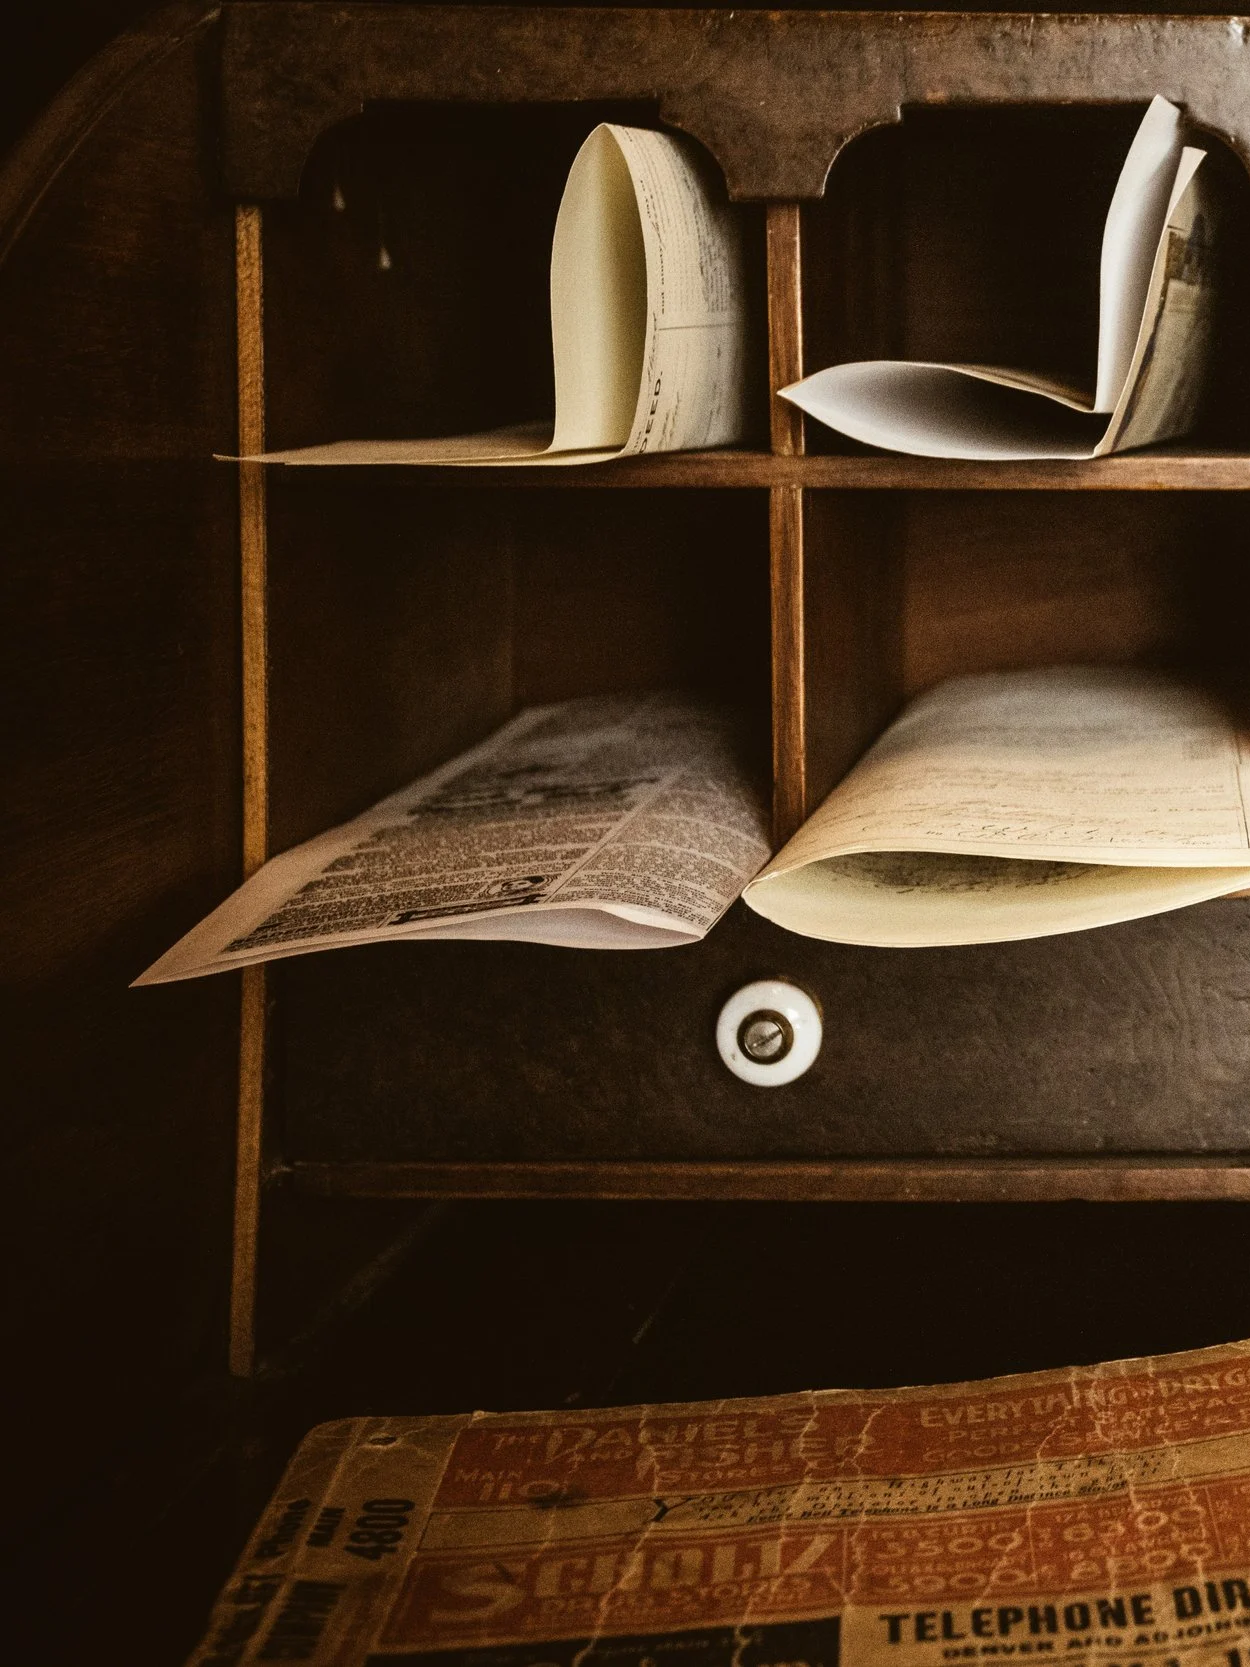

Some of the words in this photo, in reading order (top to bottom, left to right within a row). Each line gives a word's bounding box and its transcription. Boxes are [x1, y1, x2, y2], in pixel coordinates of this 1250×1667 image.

[640, 371, 663, 453] DEED.
[919, 1386, 1129, 1428] EVERYTHING
[948, 1416, 1077, 1442] PERFECT
[544, 1413, 820, 1464] DANIELS
[635, 1434, 884, 1480] FISHER
[344, 1498, 416, 1562] 4800
[840, 1504, 919, 1517] Telephone
[879, 1593, 1157, 1645] TELEPHONE
[943, 1639, 1055, 1659] DENVER
[1067, 1635, 1124, 1649] AND
